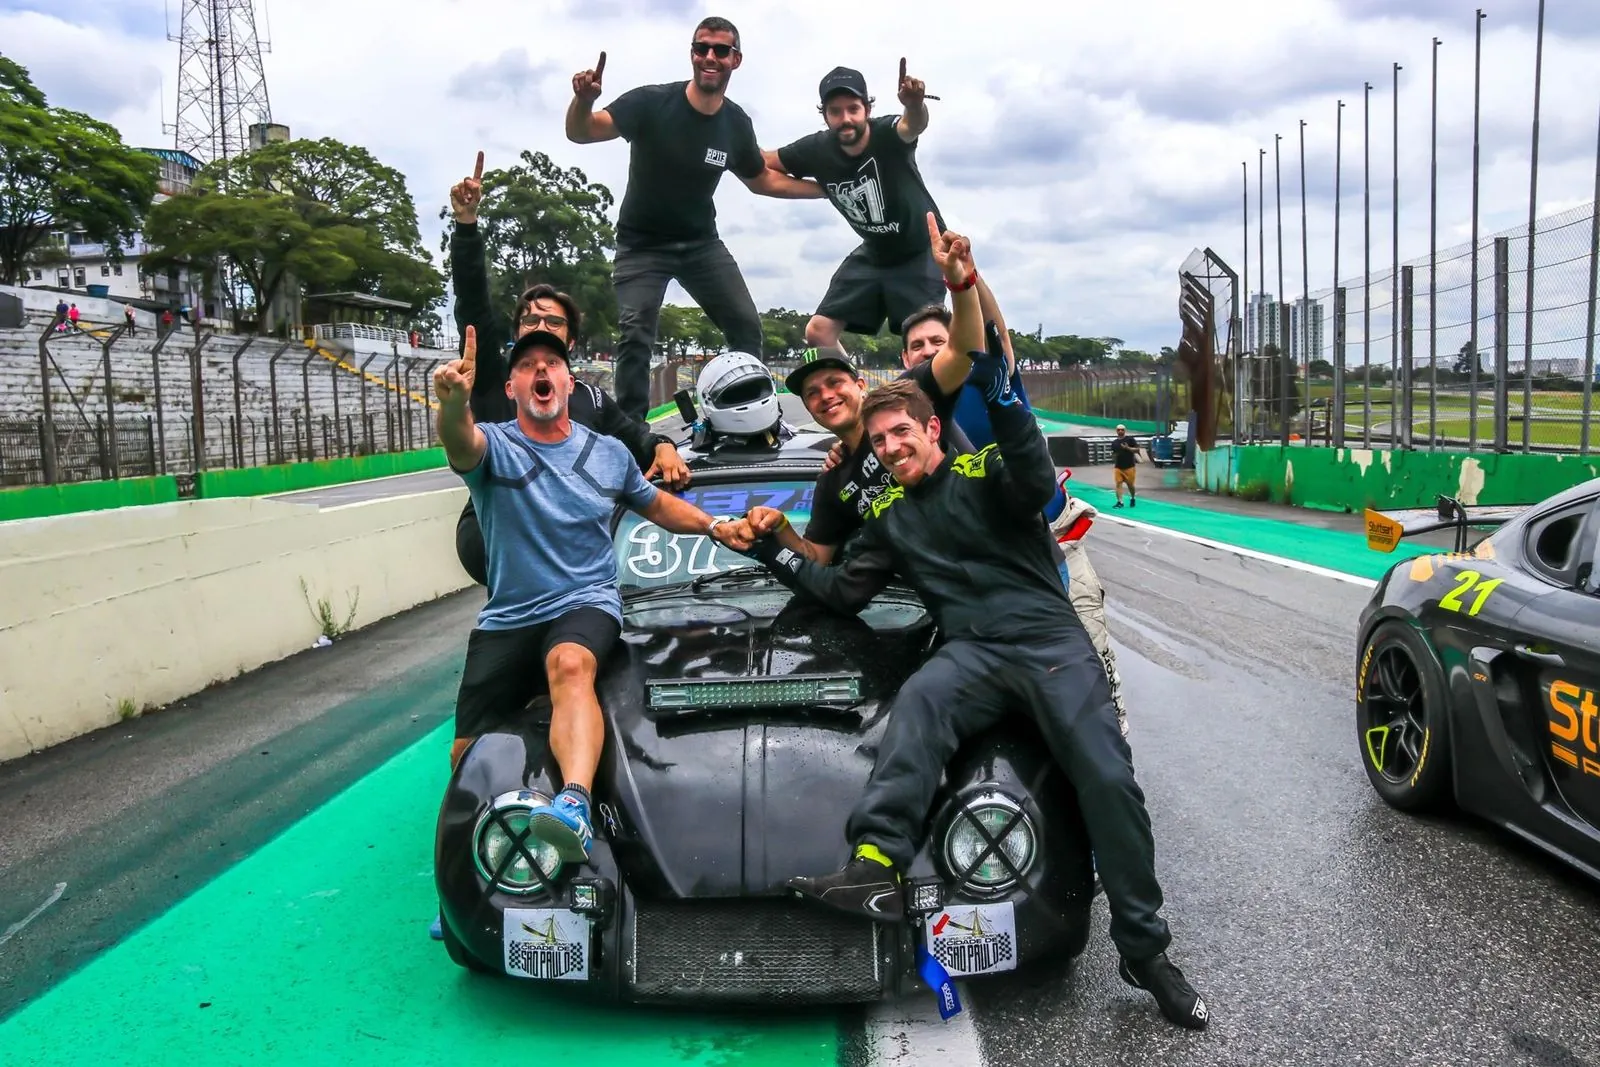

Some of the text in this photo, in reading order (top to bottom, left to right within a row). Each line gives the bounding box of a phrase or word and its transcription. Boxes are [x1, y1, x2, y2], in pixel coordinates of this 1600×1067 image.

[1439, 570, 1505, 617] 21
[1549, 680, 1600, 754] St
[946, 938, 982, 946] CIDADE
[541, 951, 570, 979] PAULO
[968, 943, 999, 972] PAULO
